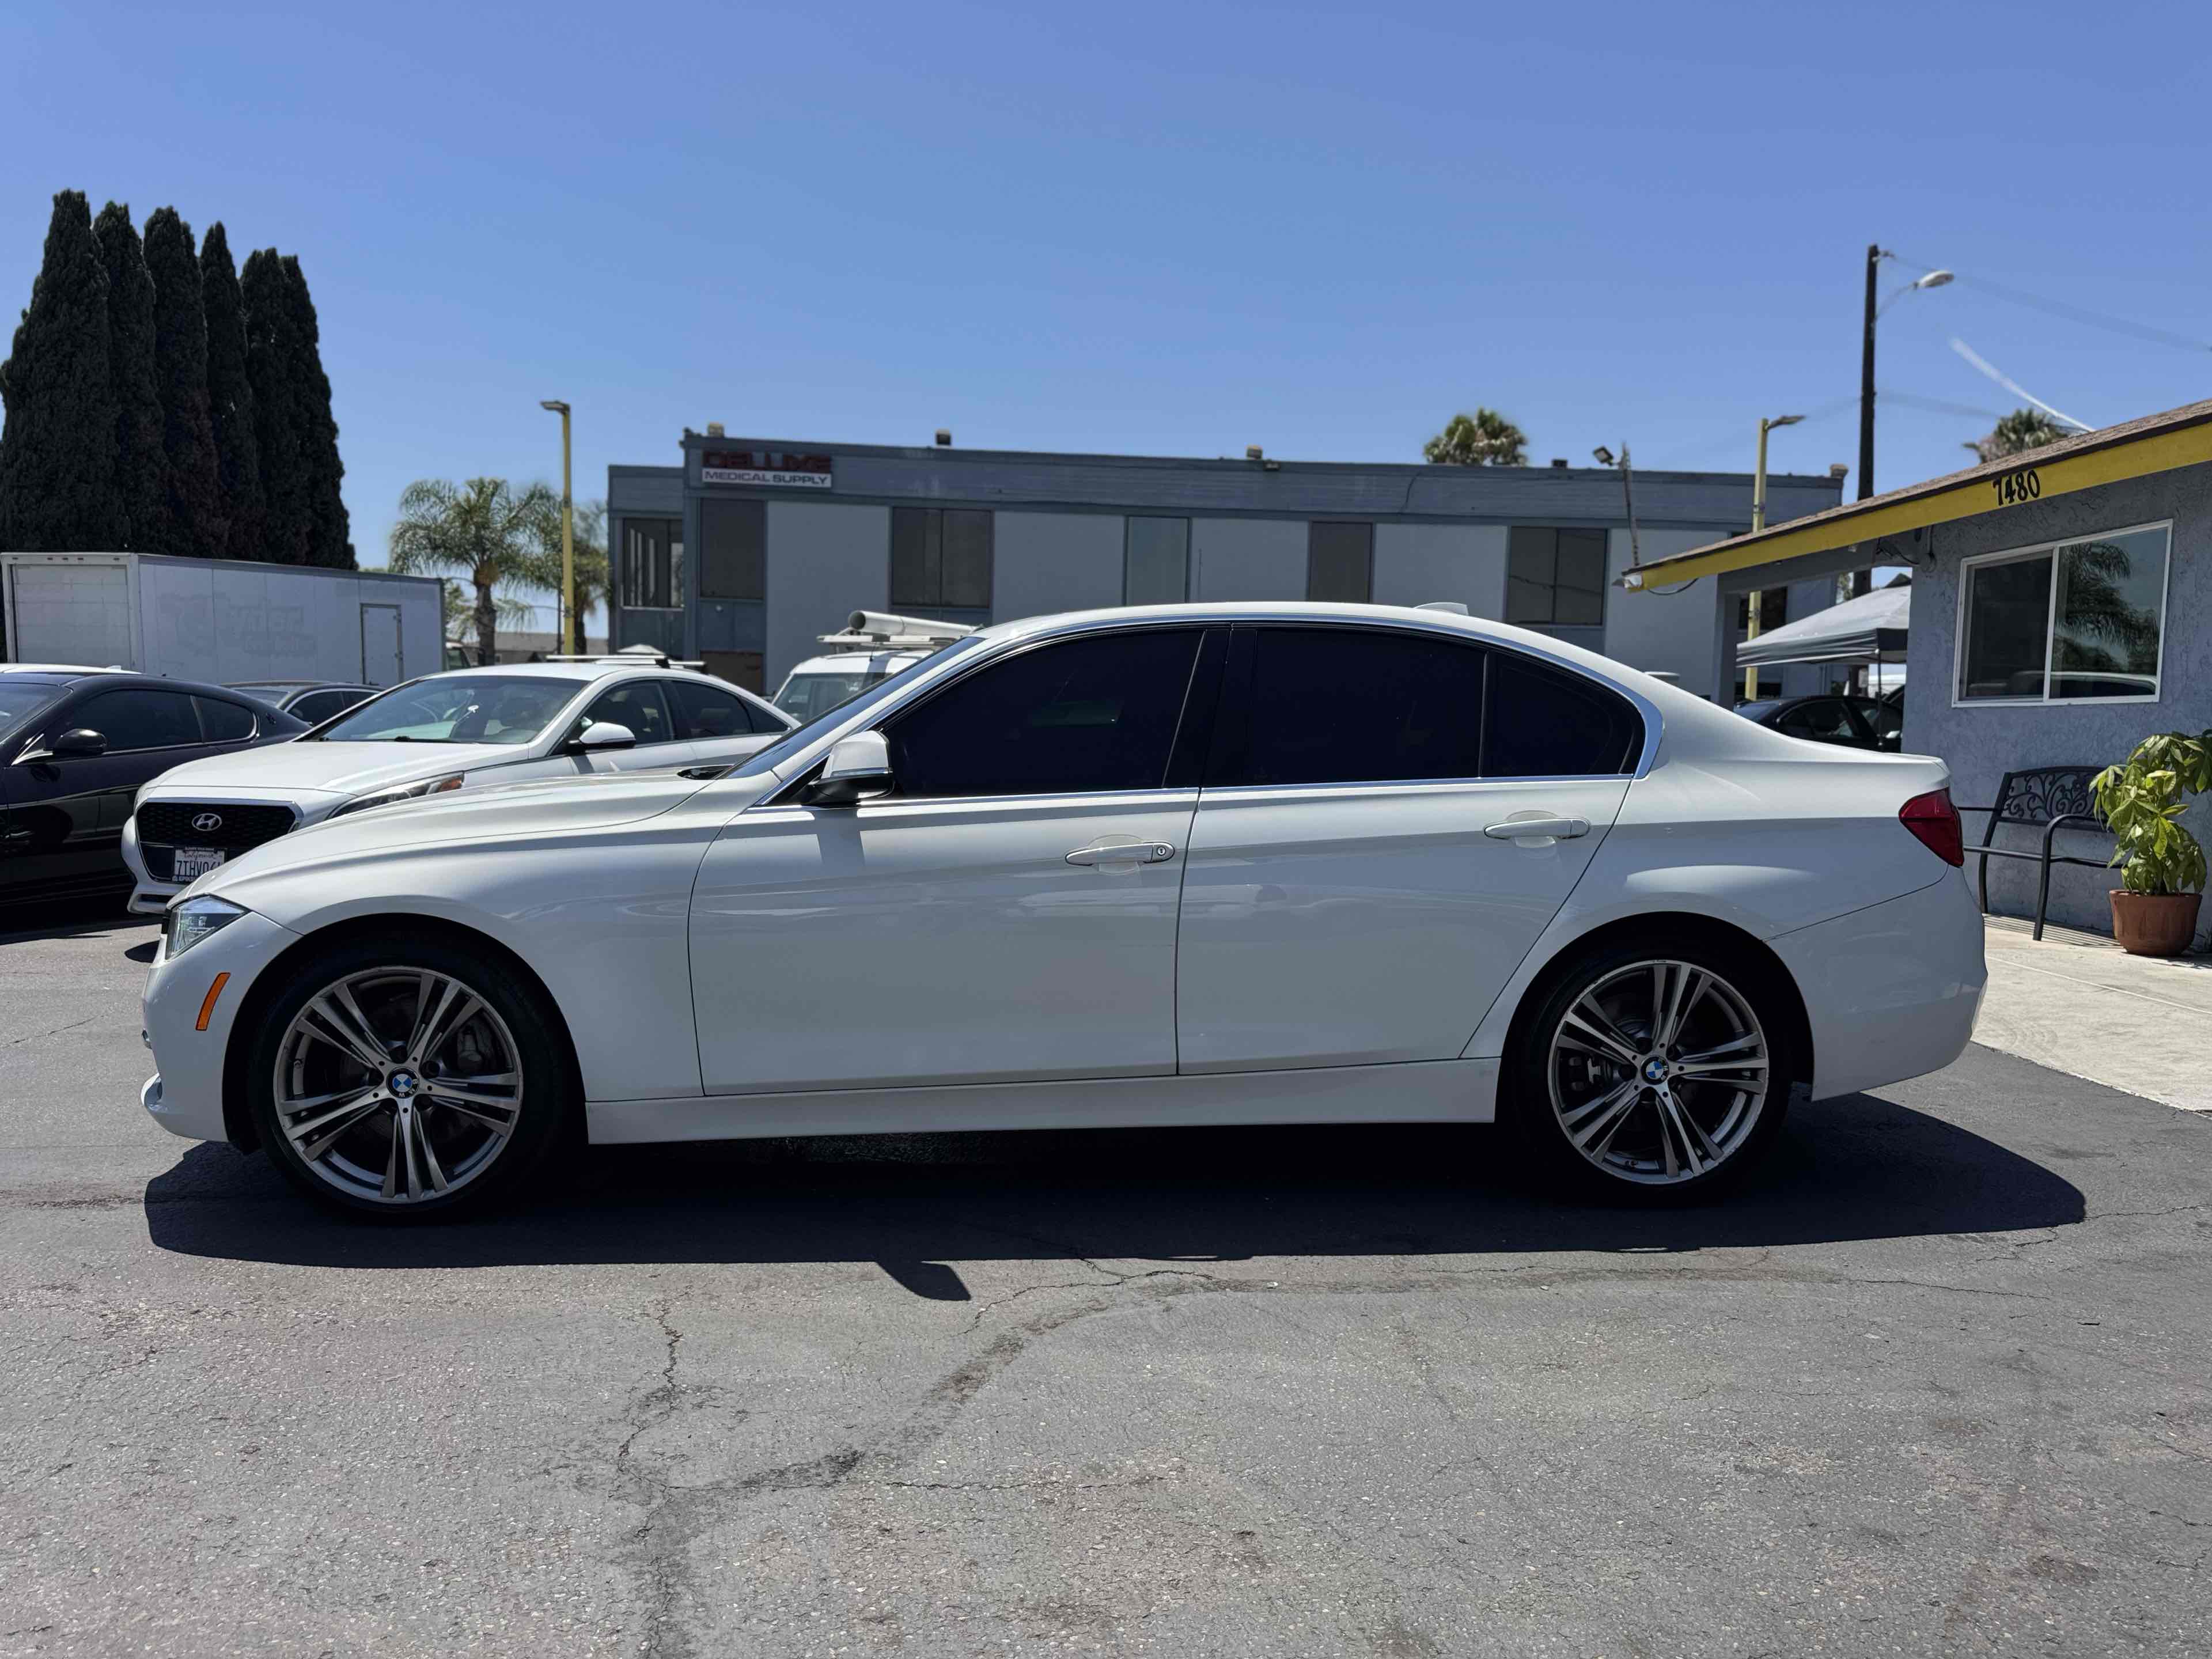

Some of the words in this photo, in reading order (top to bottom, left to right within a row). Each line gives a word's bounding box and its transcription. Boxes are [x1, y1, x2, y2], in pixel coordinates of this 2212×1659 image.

[704, 471, 770, 482] MEDICAL
[772, 474, 827, 485] SUPPLY
[1993, 469, 2040, 506] 7480
